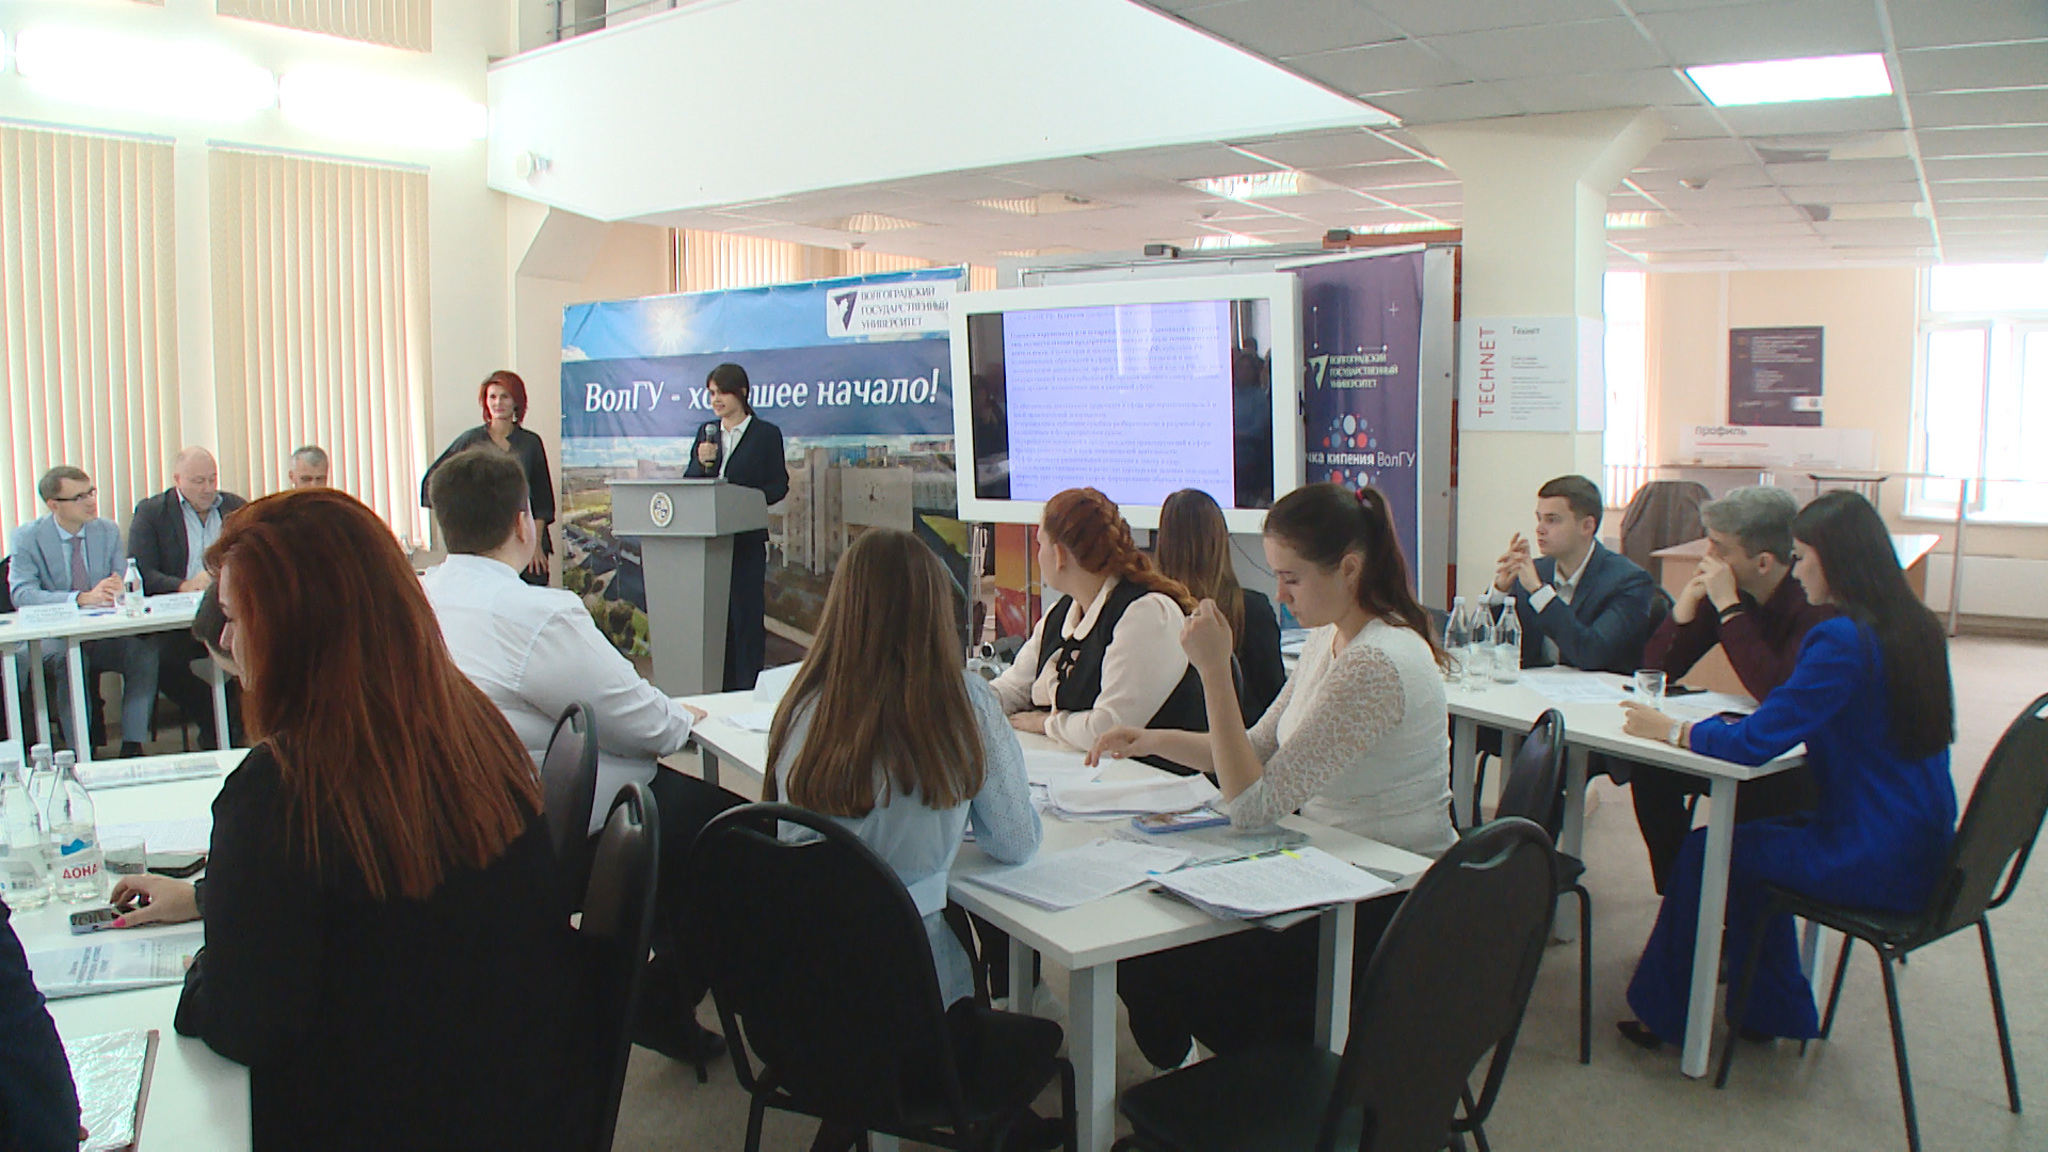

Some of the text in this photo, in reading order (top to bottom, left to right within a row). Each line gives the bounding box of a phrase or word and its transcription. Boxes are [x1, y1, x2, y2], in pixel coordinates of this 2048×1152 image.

[861, 286, 935, 300] ВОЛГОГРАДСКИЙ
[861, 300, 949, 315] ГОСУДАРСТВЕННЫЙ
[861, 317, 922, 330] УНИВЕРСИТЕТ
[1478, 326, 1496, 418] TECHNET
[585, 380, 665, 413] ВолГУ
[687, 382, 808, 410] хошее
[817, 367, 940, 407] начало!
[1327, 452, 1375, 465] кипения
[1377, 451, 1416, 468] ВолГУ
